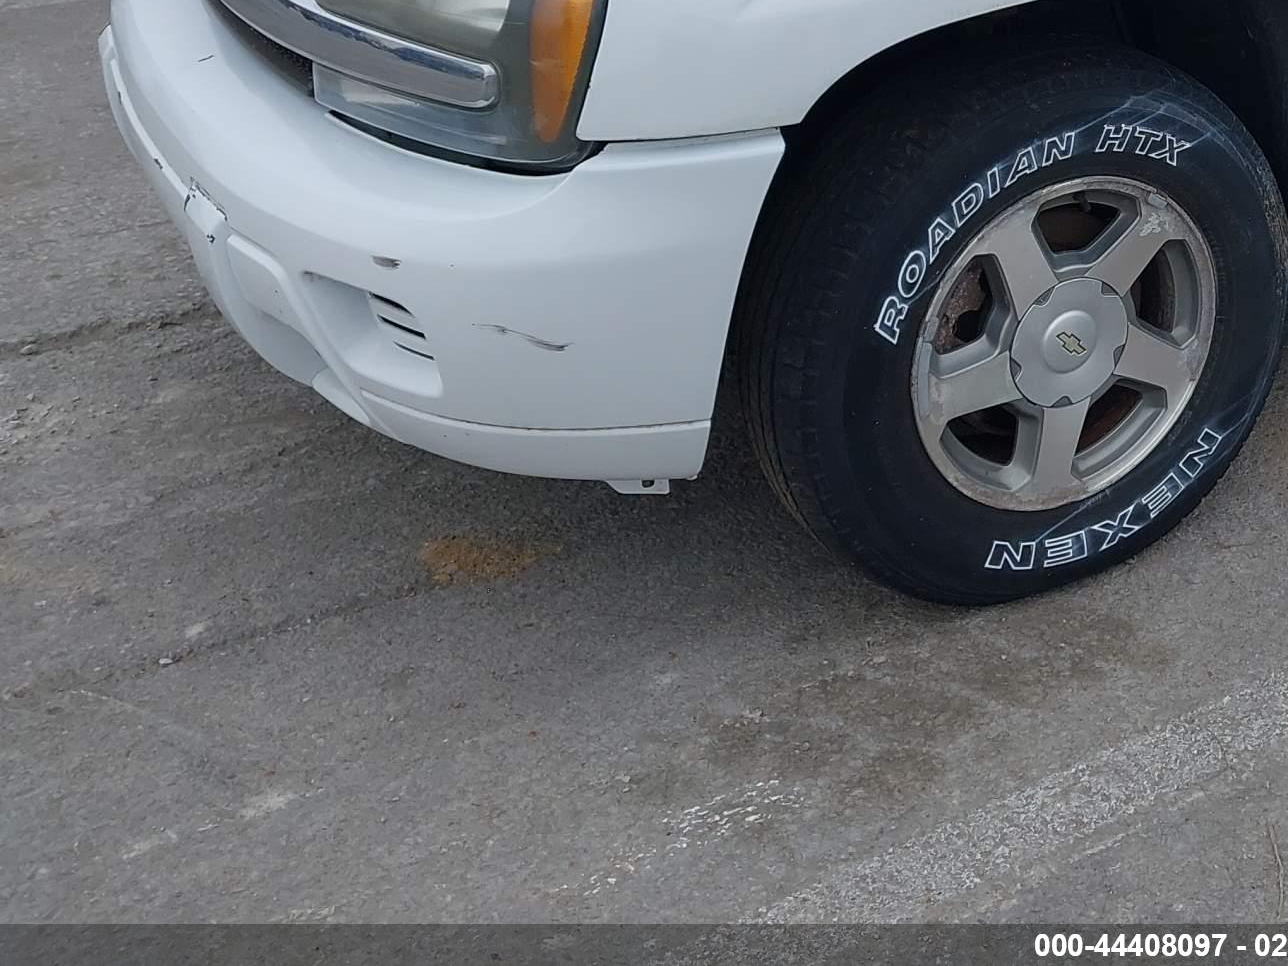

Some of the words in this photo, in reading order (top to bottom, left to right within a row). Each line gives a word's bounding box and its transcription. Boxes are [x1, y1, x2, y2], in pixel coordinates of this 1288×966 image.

[874, 131, 1075, 344] ROADIAN
[1095, 123, 1191, 166] HTX
[984, 427, 1222, 570] NEXEN
